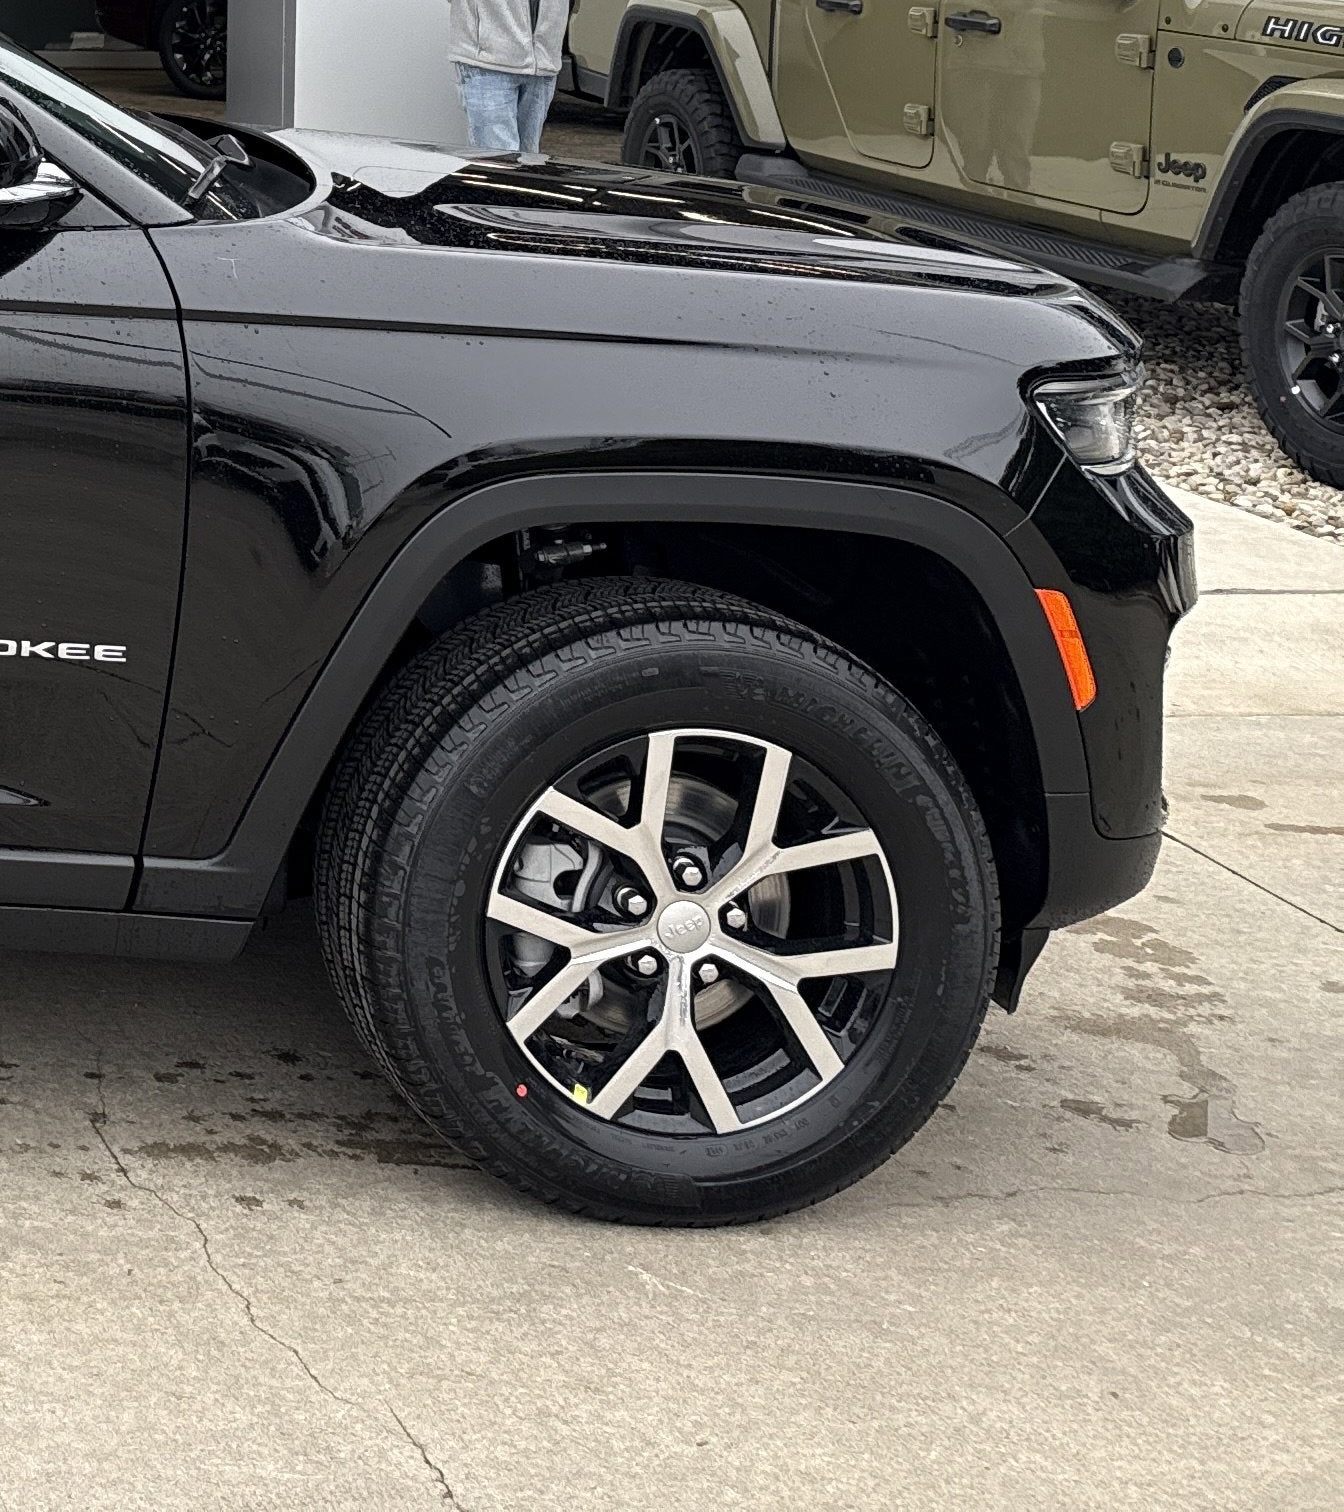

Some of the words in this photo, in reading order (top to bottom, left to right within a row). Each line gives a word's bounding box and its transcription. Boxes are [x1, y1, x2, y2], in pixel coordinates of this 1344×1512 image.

[1262, 16, 1344, 48] HIG
[1157, 152, 1207, 183] Jeep
[664, 915, 703, 939] Jeep
